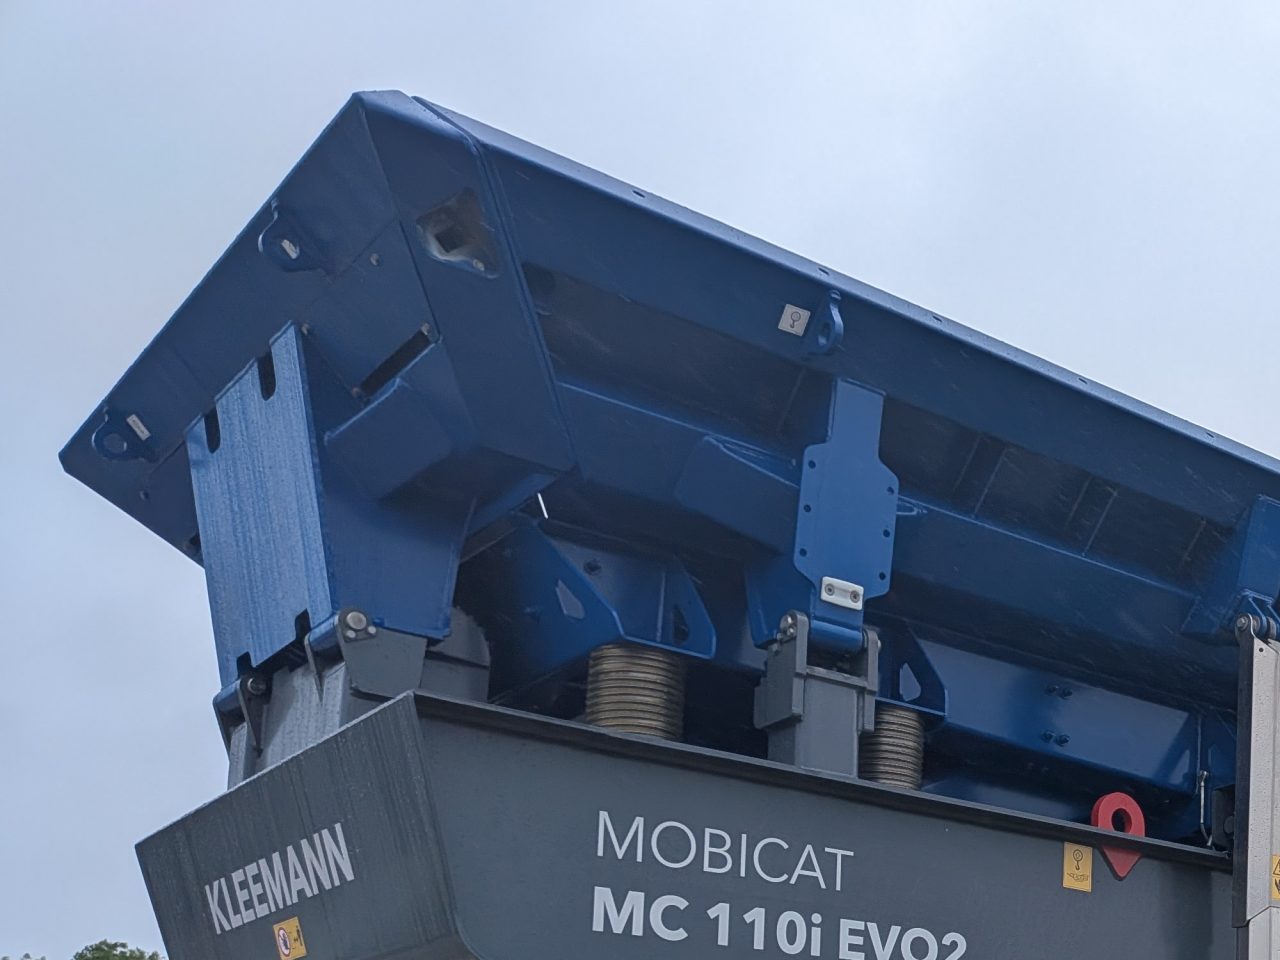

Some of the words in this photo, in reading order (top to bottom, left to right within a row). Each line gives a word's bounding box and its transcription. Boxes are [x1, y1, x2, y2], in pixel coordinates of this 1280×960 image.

[204, 822, 355, 935] KLEEMANN
[596, 810, 855, 892] MOBICAT
[591, 886, 690, 942] MC
[706, 902, 823, 957] 110i
